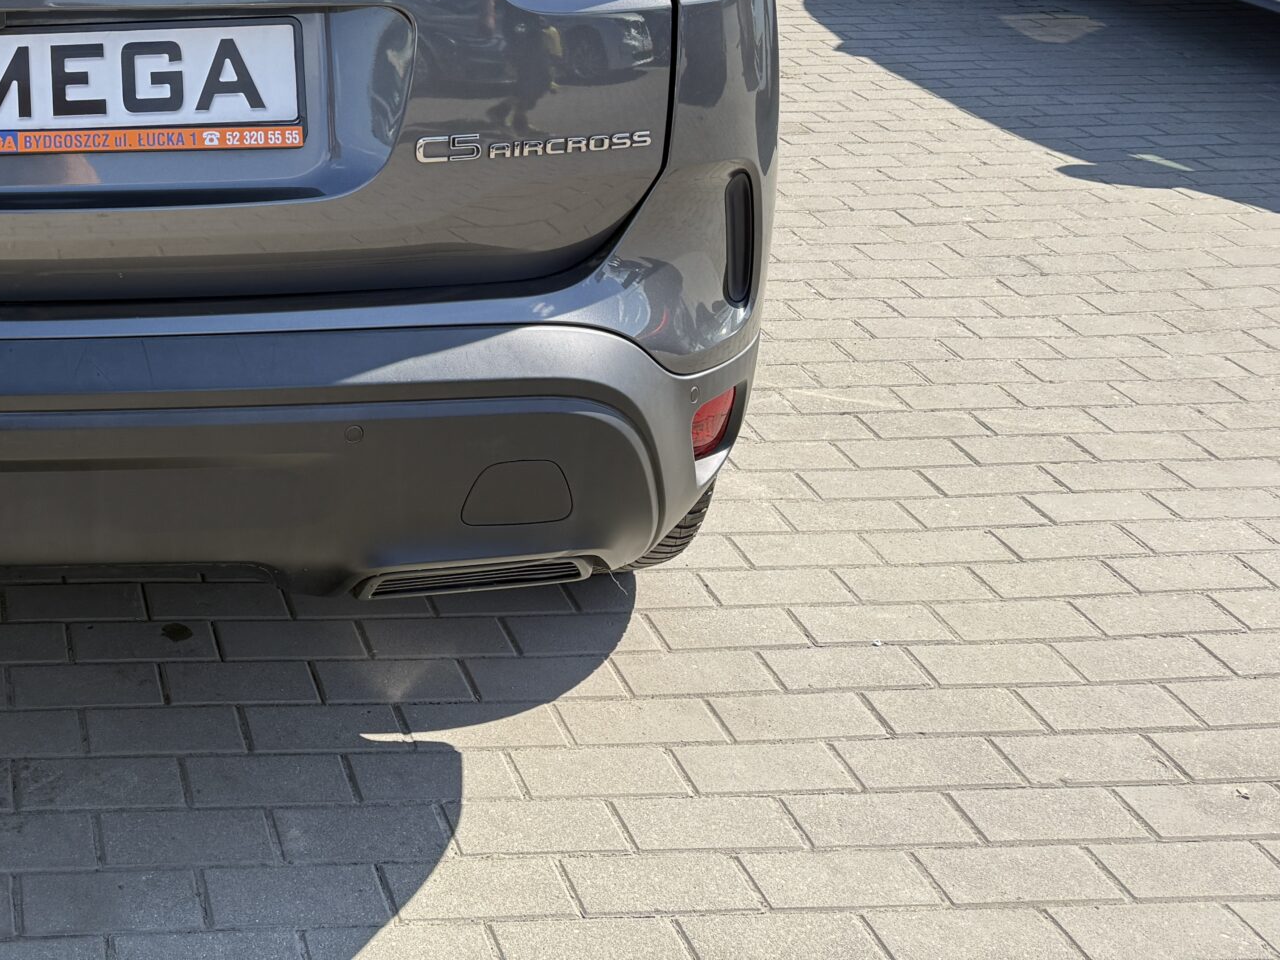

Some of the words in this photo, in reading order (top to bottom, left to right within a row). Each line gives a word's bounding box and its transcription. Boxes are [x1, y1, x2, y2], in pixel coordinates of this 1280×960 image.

[24, 133, 109, 149] BYDGOSZCZ
[115, 134, 132, 147] ul.
[137, 132, 186, 147] ŁUCKA
[190, 132, 197, 145] 1
[226, 131, 240, 145] 52
[243, 131, 265, 145] 320
[267, 130, 282, 144] 55
[285, 130, 300, 144] 55
[415, 133, 482, 164] C5
[489, 130, 652, 159] AIRCROSS
